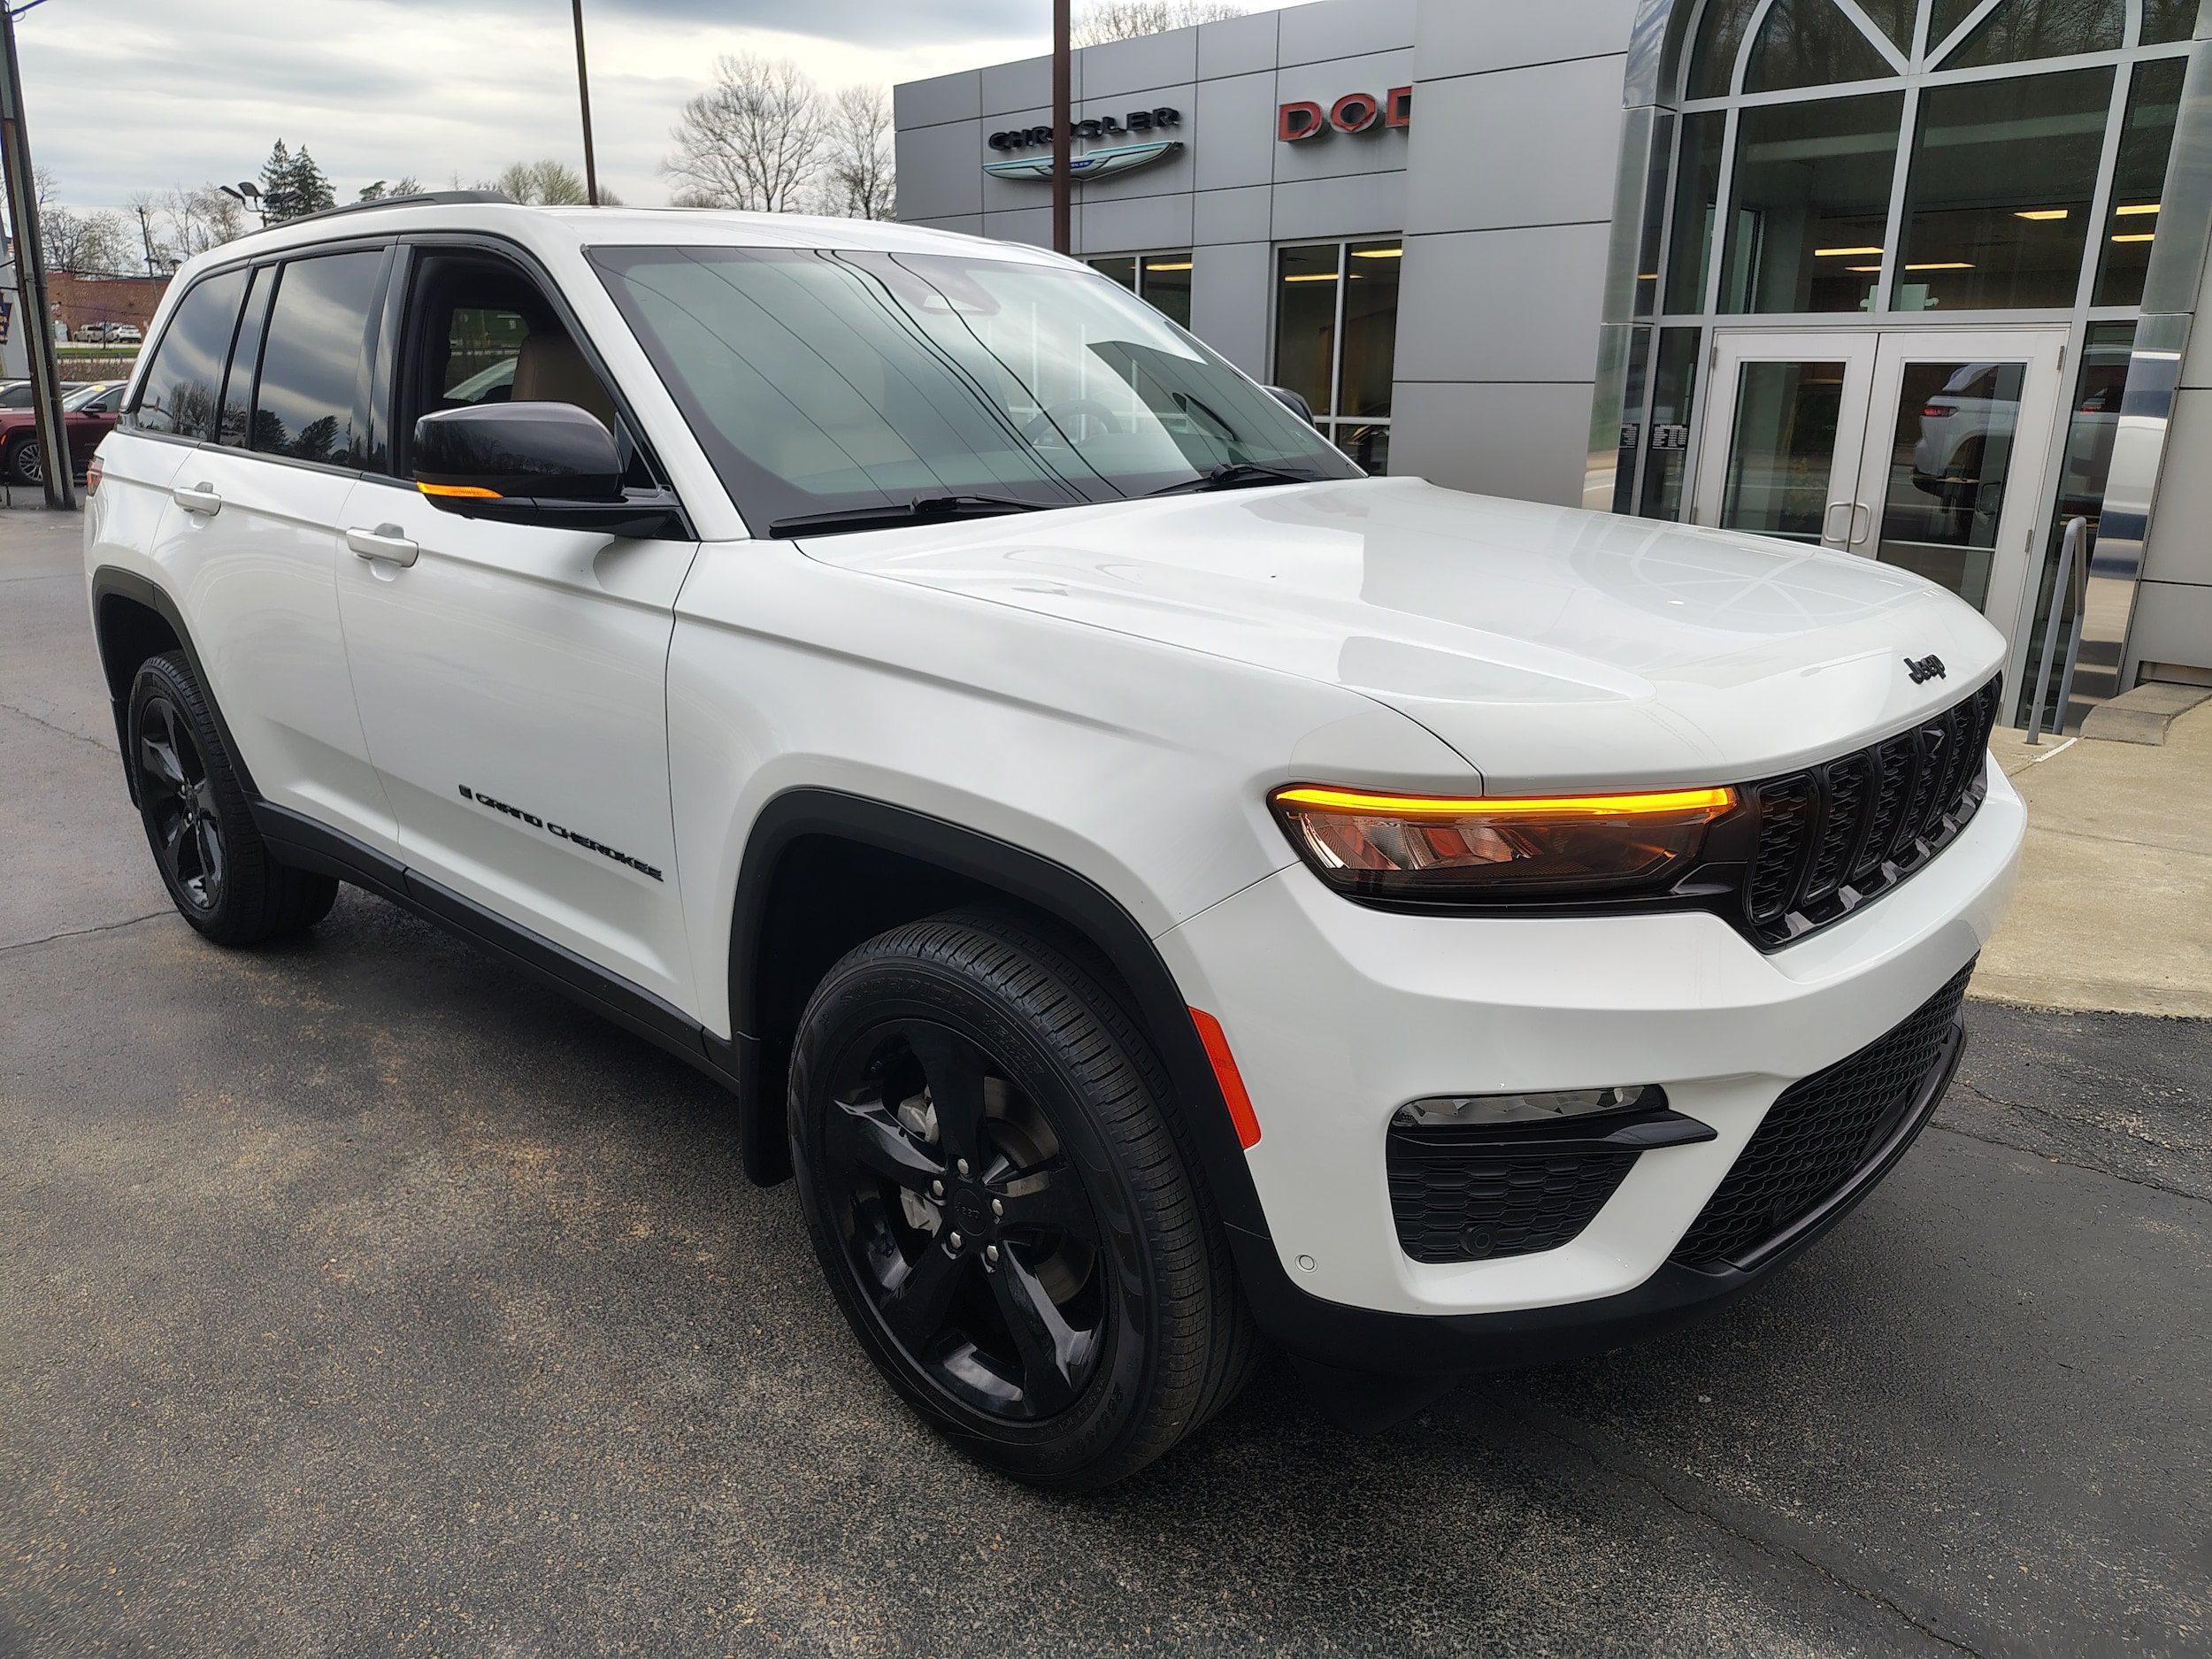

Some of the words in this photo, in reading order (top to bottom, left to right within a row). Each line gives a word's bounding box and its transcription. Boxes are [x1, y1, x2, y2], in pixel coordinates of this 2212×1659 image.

[988, 107, 1180, 150] CHRSLER
[1903, 654, 1947, 685] Jeep
[475, 793, 543, 828] GRAND
[547, 822, 664, 883] CHEROKEE
